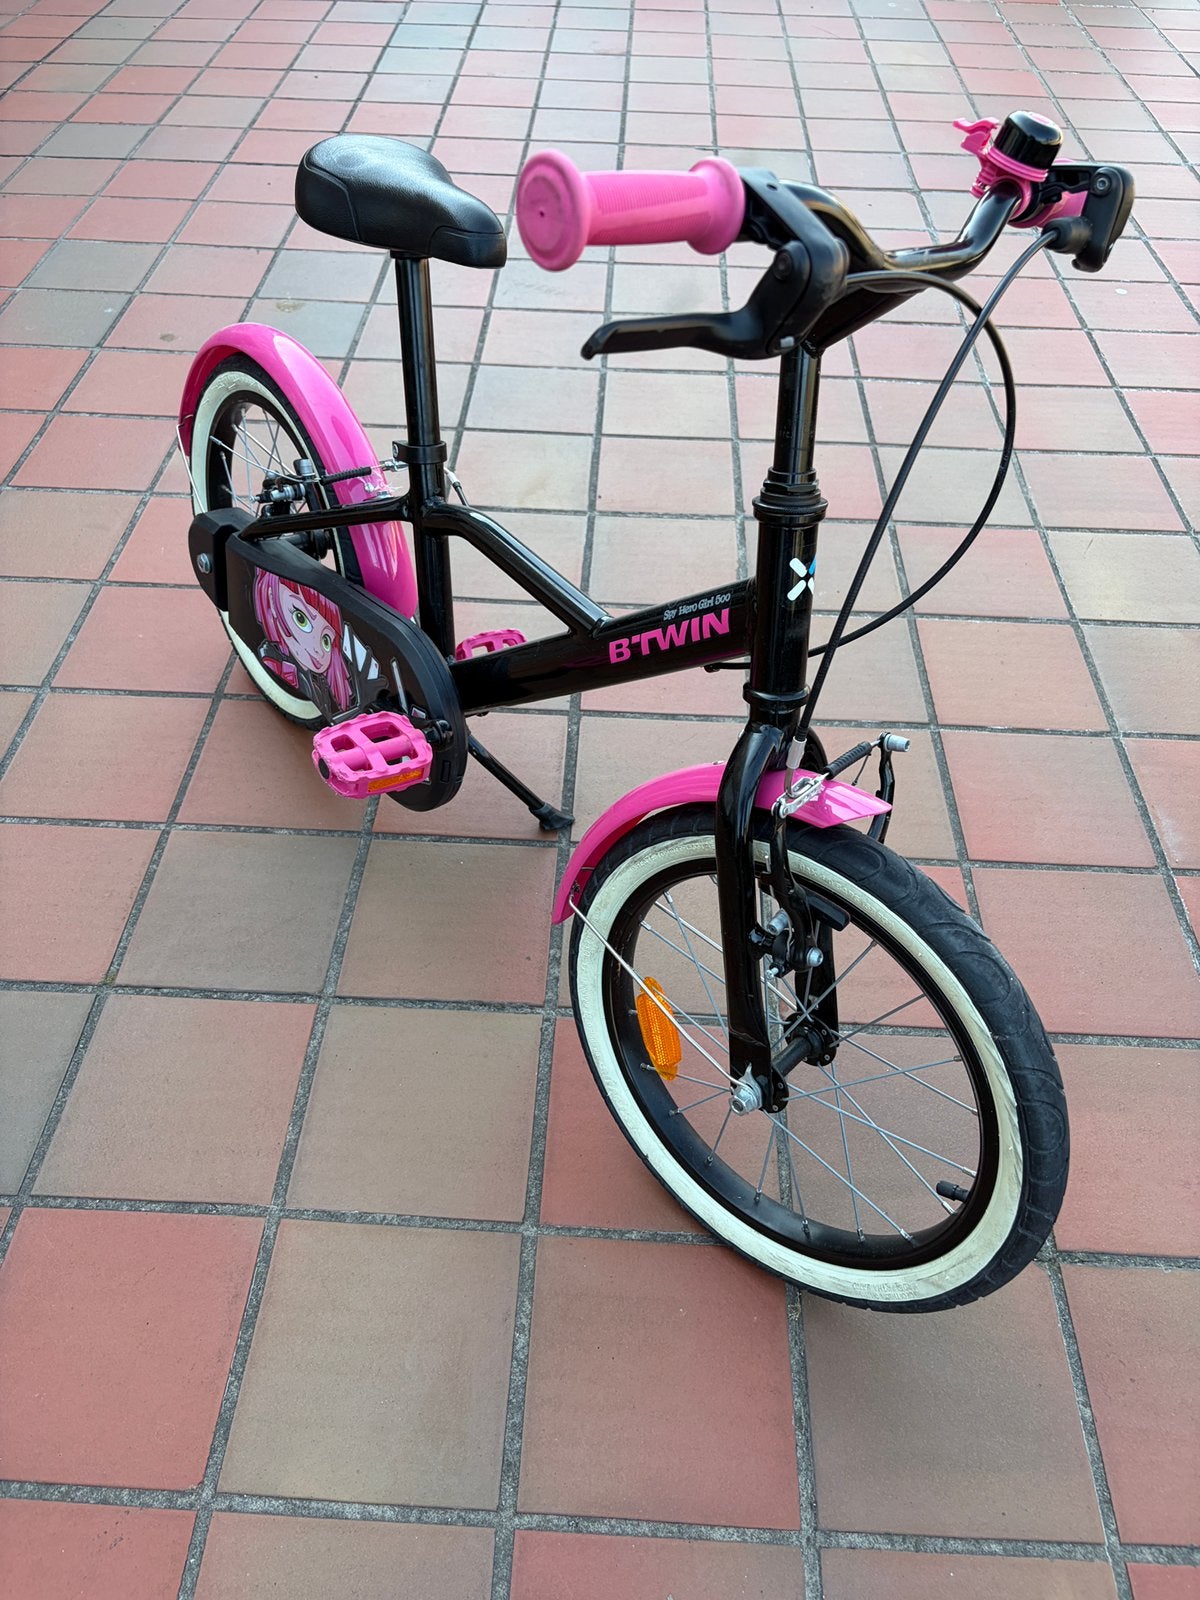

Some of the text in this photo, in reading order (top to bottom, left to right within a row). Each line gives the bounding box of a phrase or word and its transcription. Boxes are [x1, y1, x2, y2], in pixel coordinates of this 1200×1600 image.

[663, 593, 731, 621] Spy Hero Girl 500
